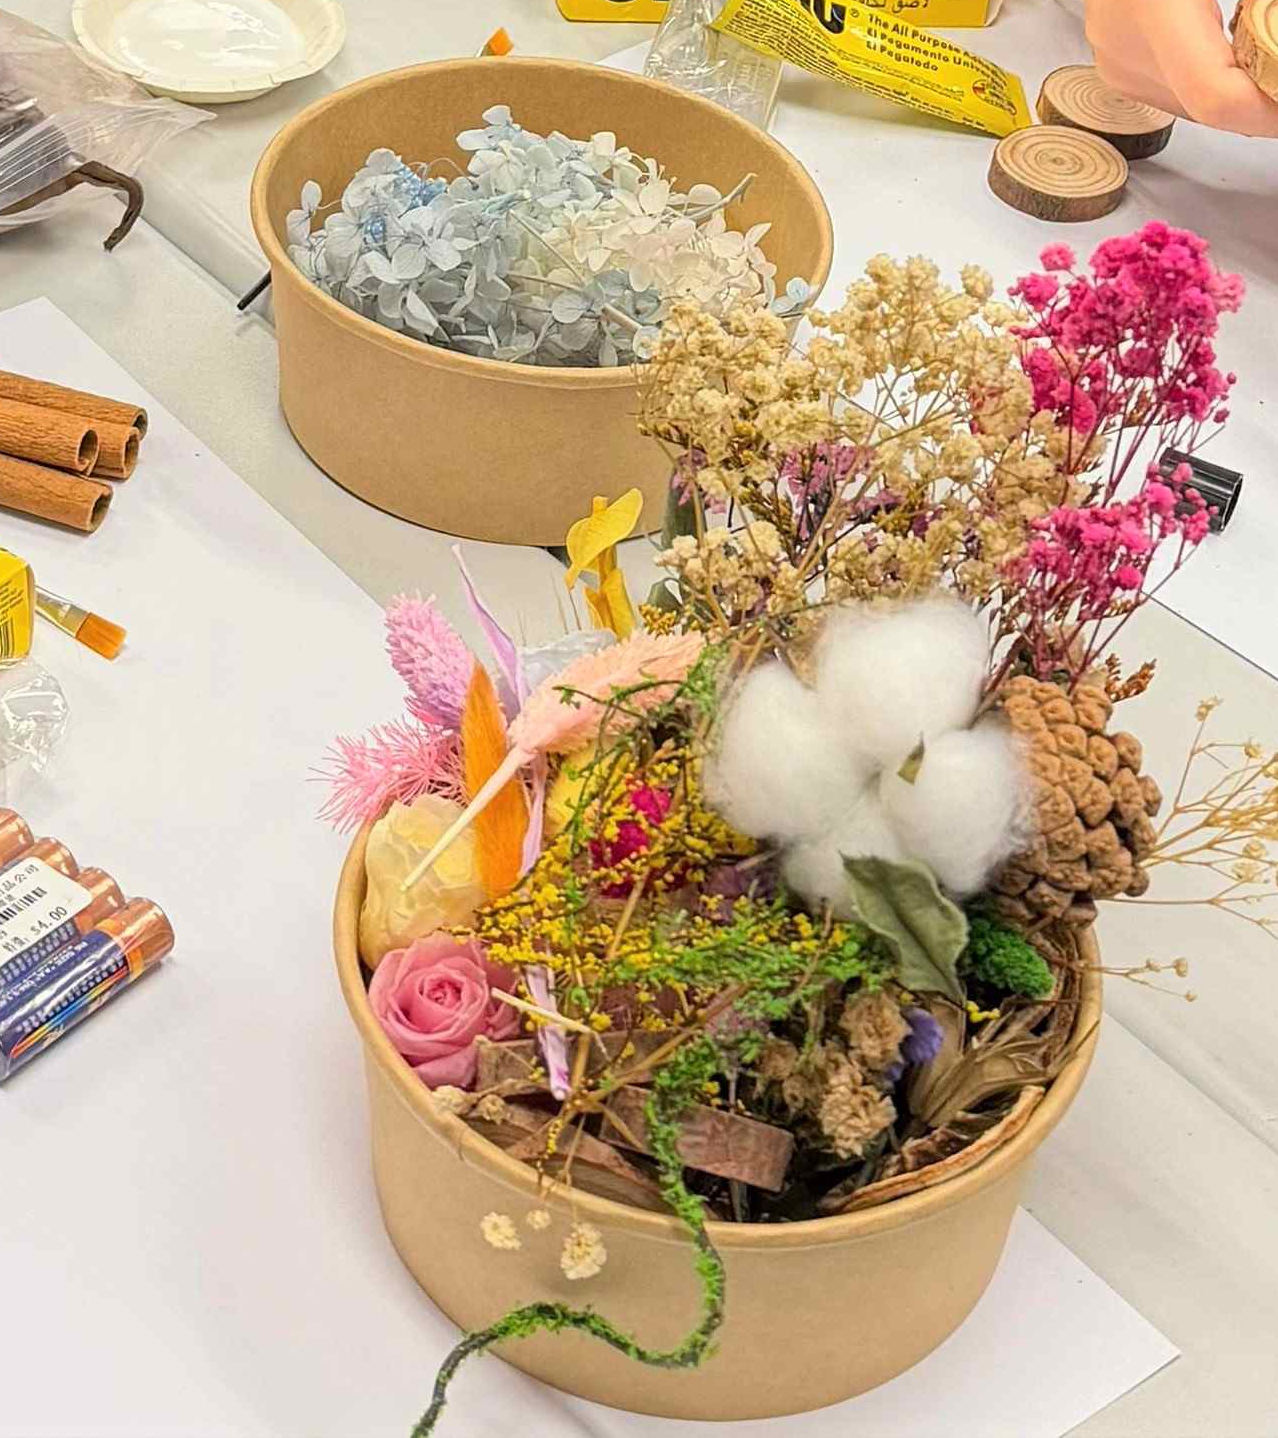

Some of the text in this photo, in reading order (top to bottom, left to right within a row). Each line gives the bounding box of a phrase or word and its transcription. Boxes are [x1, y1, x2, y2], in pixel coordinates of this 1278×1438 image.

[867, 14, 889, 30] The
[891, 23, 908, 37] All
[912, 29, 962, 54] Purpose
[880, 31, 950, 63] Pegamento
[879, 45, 939, 72] Pegatodo
